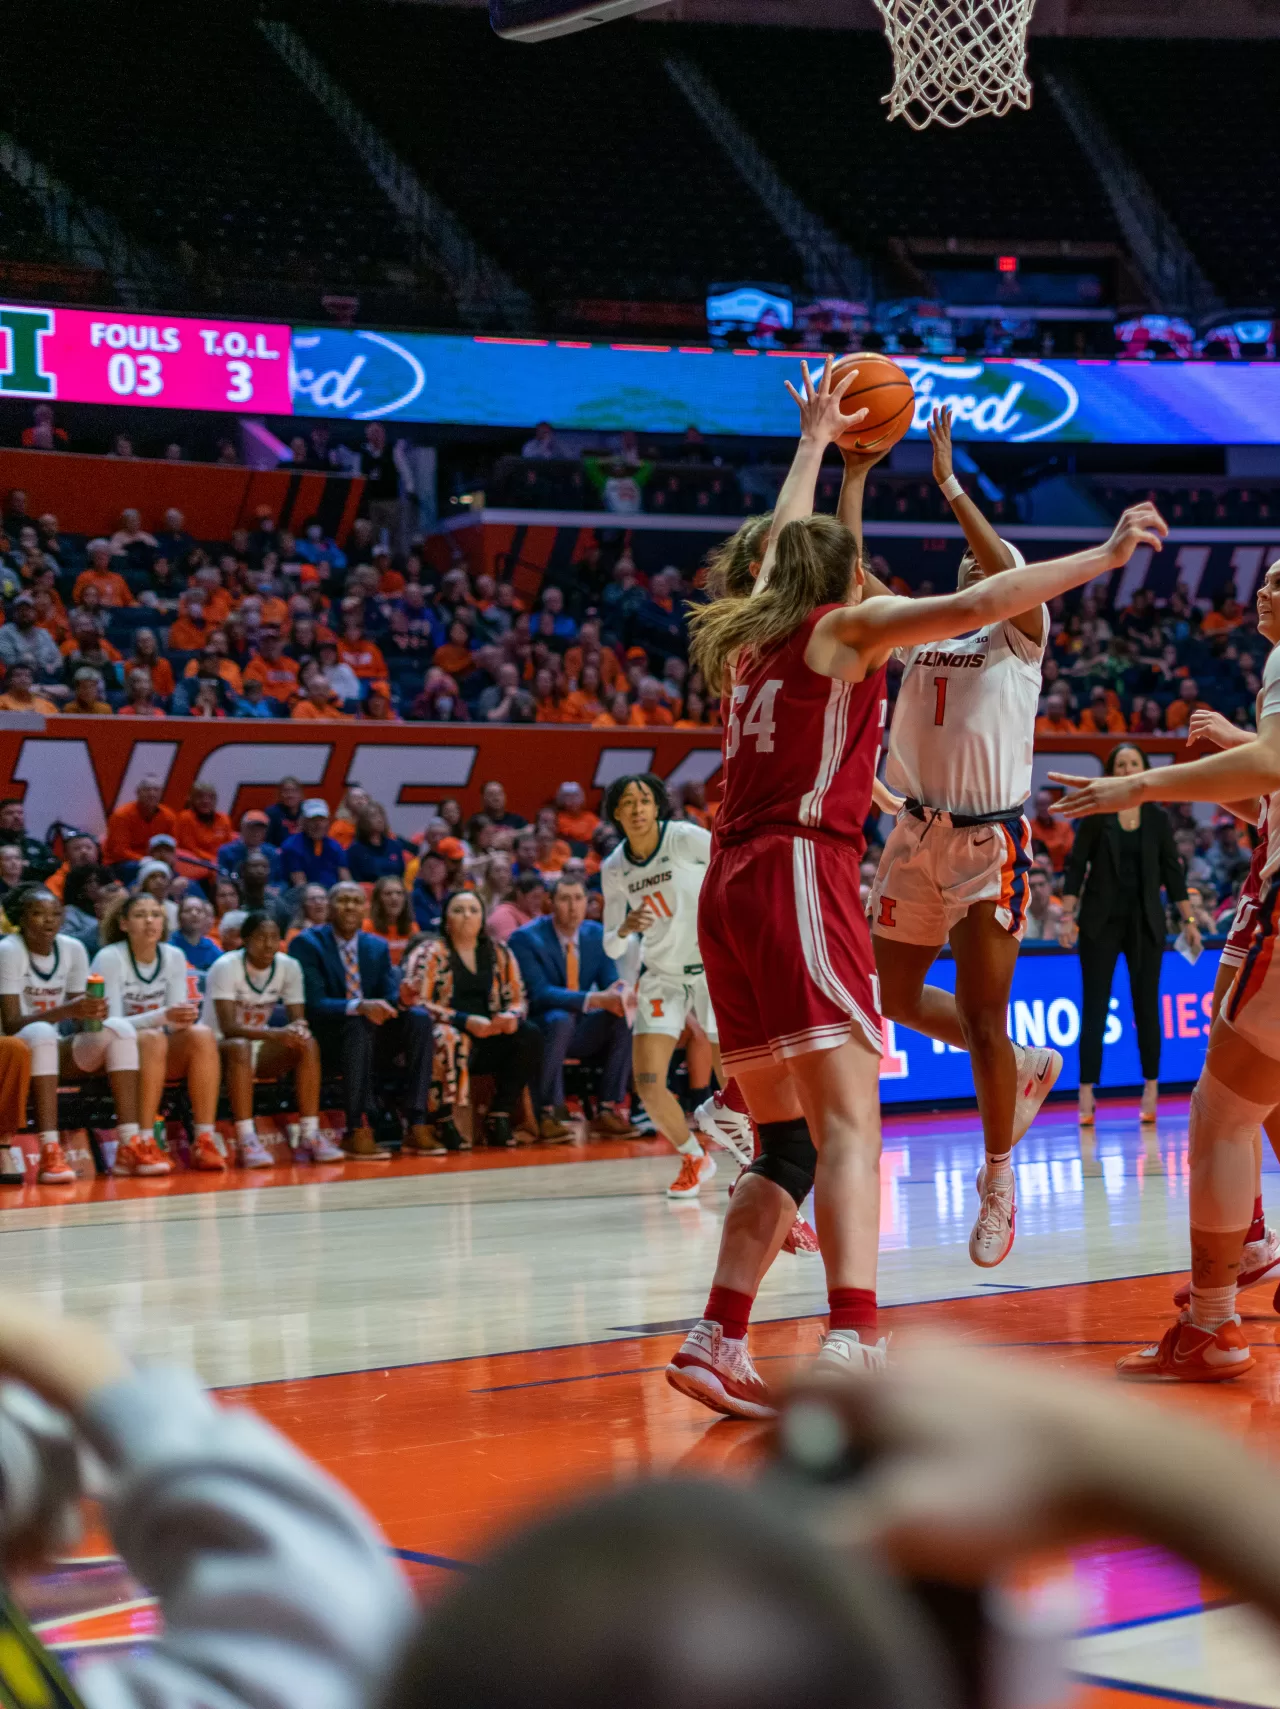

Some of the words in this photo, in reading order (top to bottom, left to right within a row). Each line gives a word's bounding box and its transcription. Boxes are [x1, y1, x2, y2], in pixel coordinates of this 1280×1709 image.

[90, 323, 181, 353] FOULS
[199, 330, 280, 360] T.O.L.
[107, 353, 163, 397] 03
[226, 361, 254, 402] 3
[933, 677, 948, 726] 1
[628, 870, 673, 894] ILLINOIS
[642, 890, 674, 918] 11
